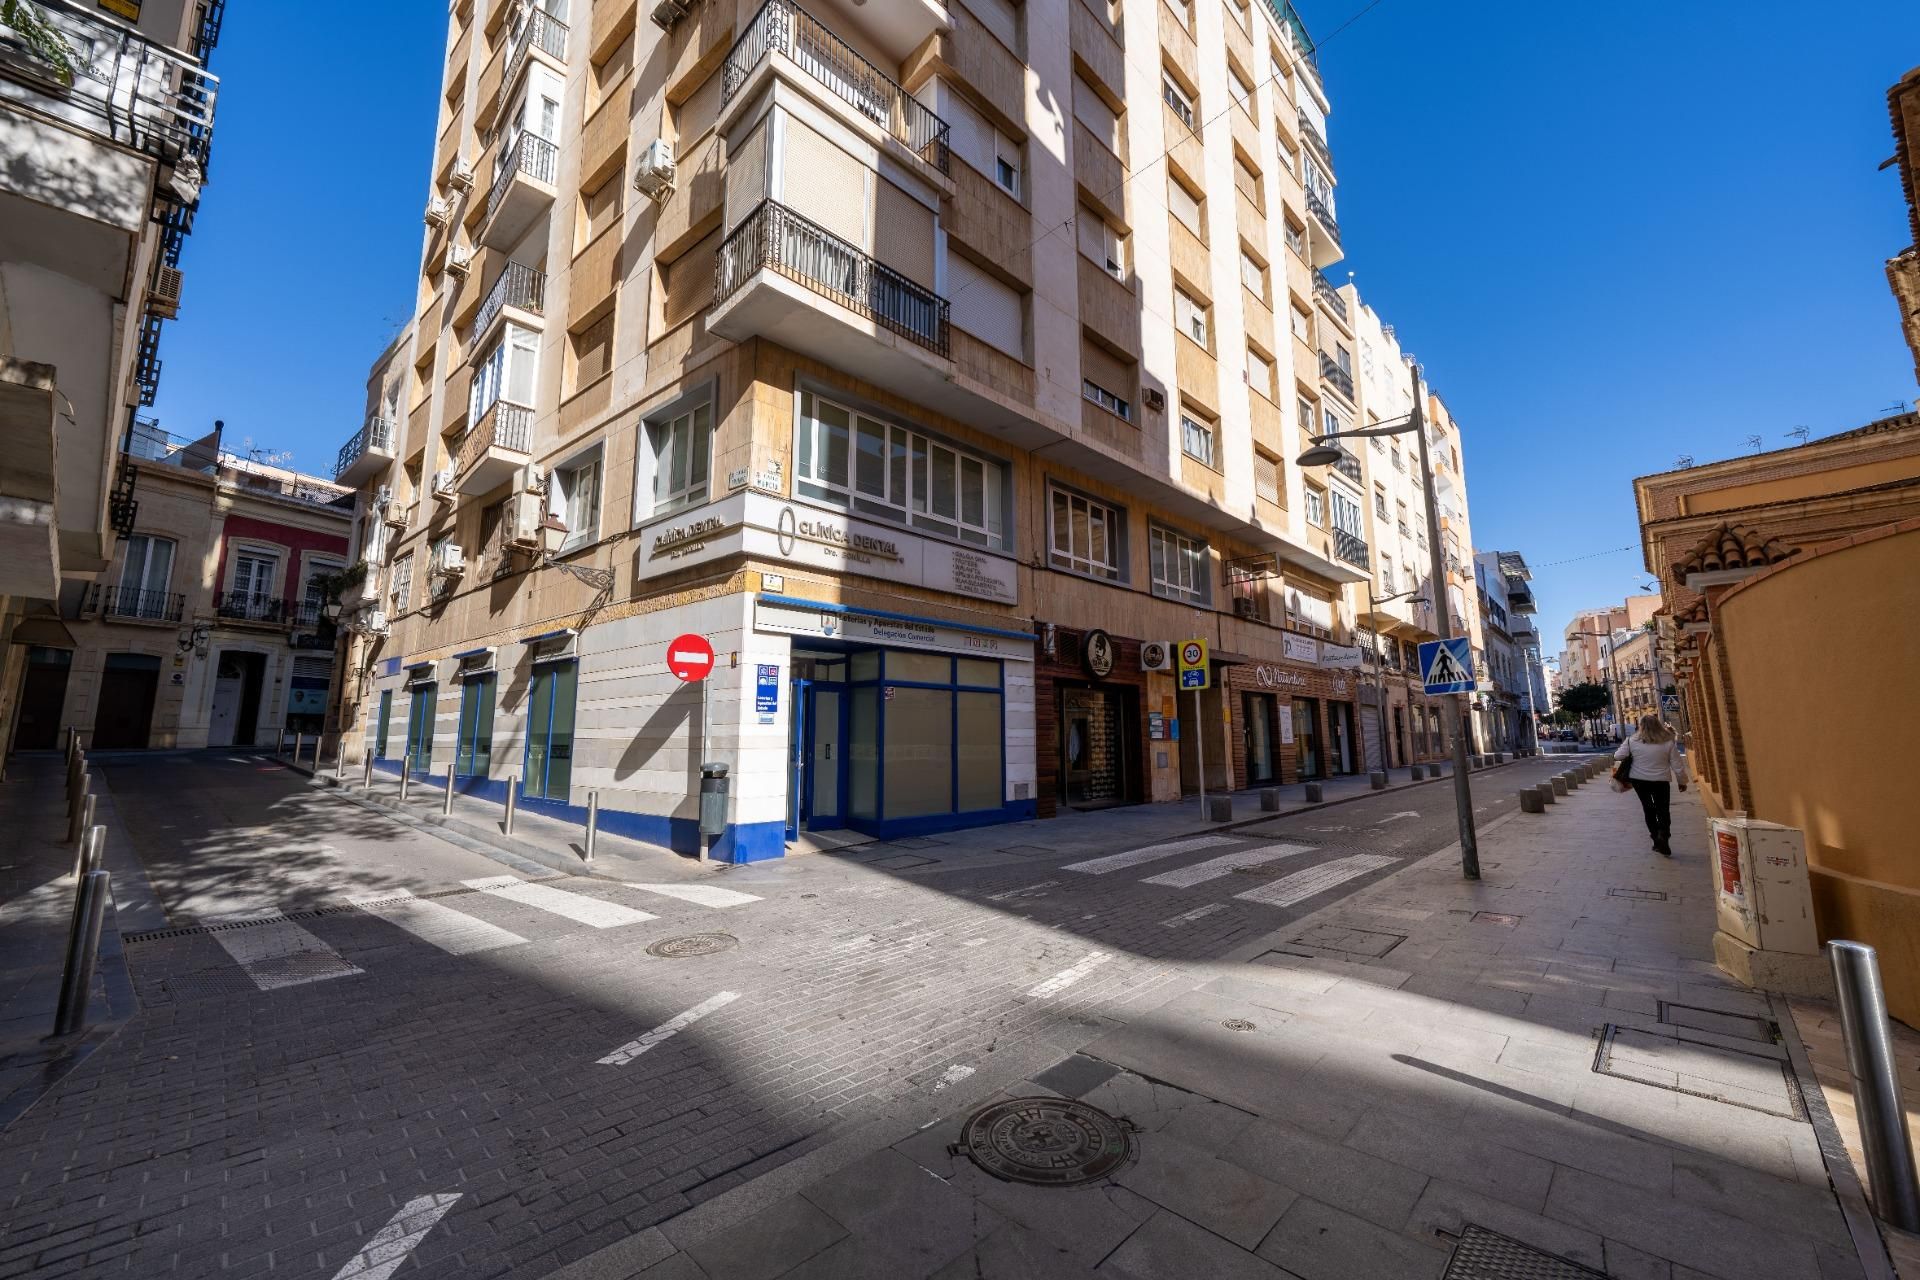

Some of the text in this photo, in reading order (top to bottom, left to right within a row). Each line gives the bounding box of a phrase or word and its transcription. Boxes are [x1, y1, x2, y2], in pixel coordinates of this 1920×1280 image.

[853, 534, 899, 555] DENTAL
[874, 618, 903, 631] Apuestas
[904, 622, 914, 631] del
[873, 627, 936, 642] Delegación Comercial
[1187, 649, 1199, 658] 30
